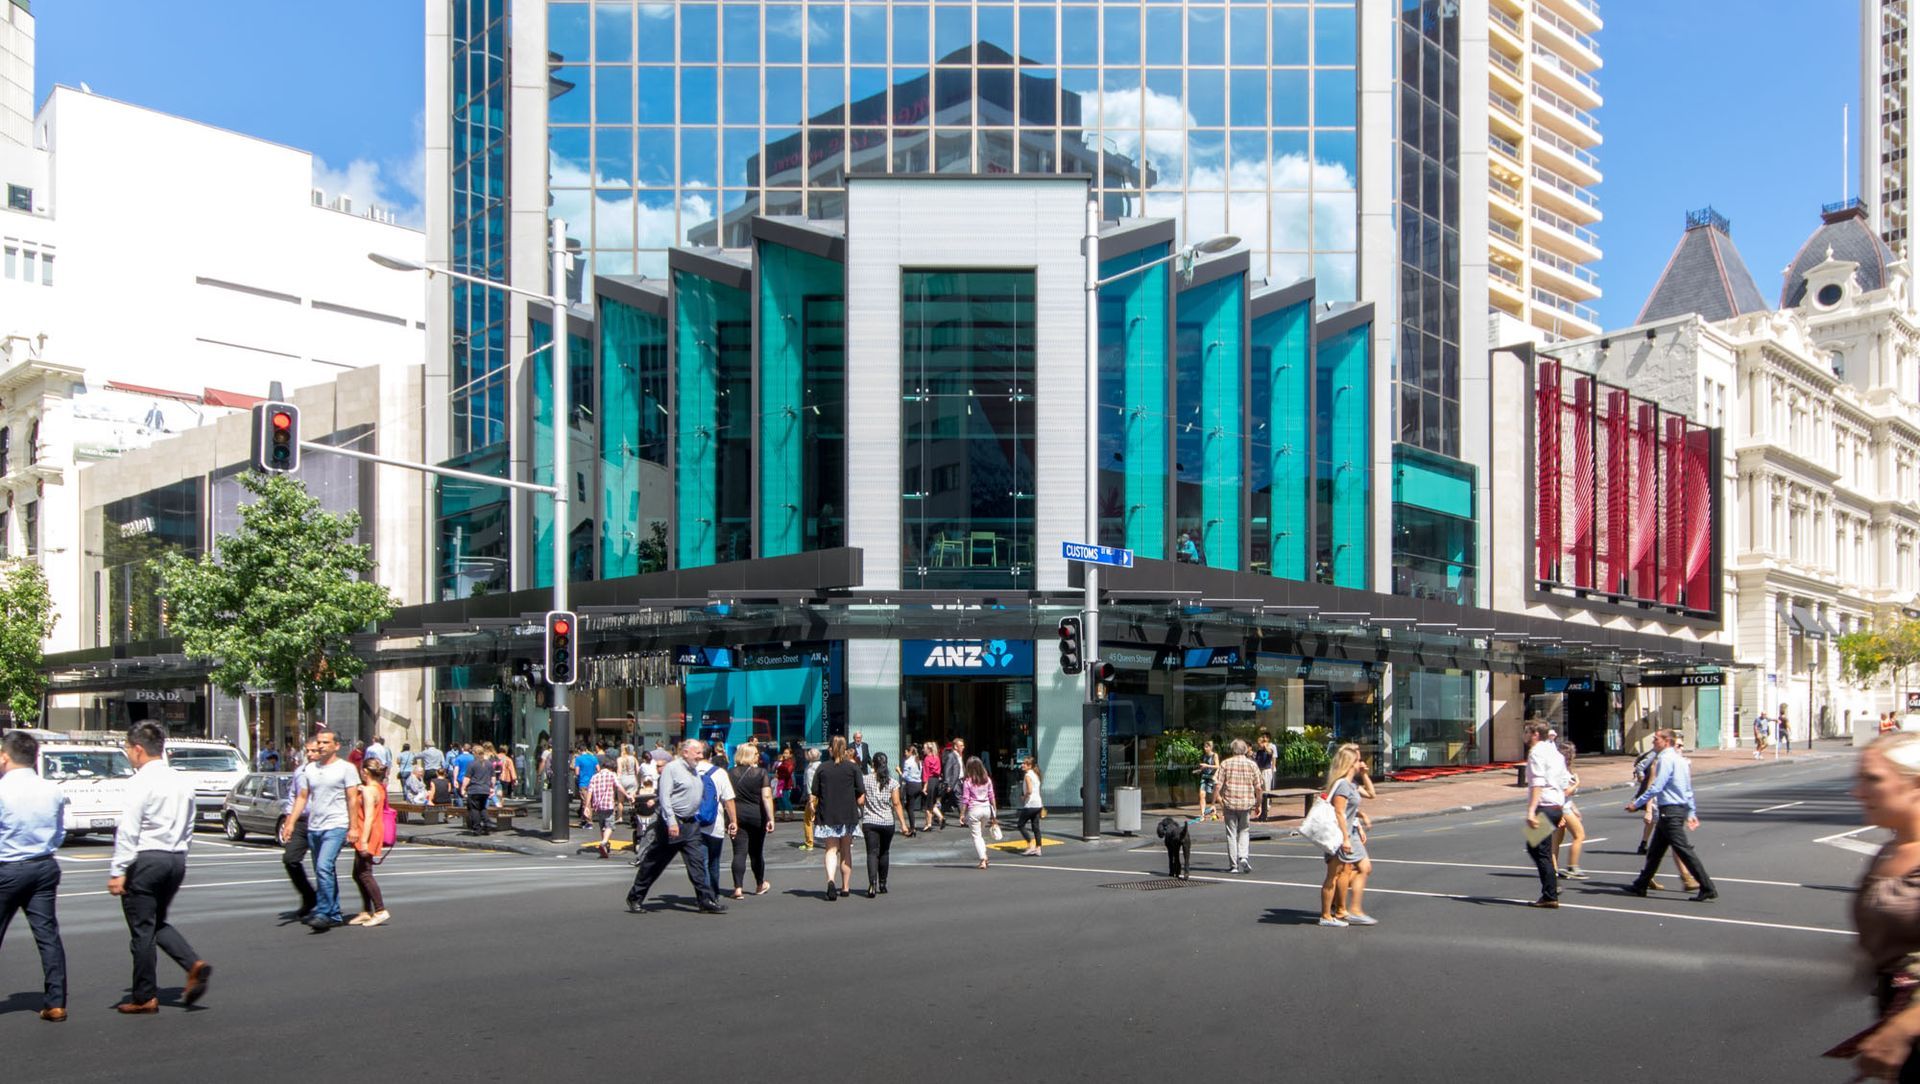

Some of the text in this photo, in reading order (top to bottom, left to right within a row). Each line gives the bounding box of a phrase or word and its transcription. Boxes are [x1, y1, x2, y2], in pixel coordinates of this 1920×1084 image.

[1066, 544, 1098, 560] CUSTOMS
[678, 654, 696, 664] ANZ
[764, 655, 782, 664] Queen
[782, 654, 798, 664] Street
[924, 646, 982, 666] ANZ
[1117, 654, 1136, 663] Queen
[1136, 655, 1152, 664] Street
[1212, 656, 1228, 664] ANZ
[1688, 675, 1720, 684] TOUS
[823, 680, 829, 690] 45
